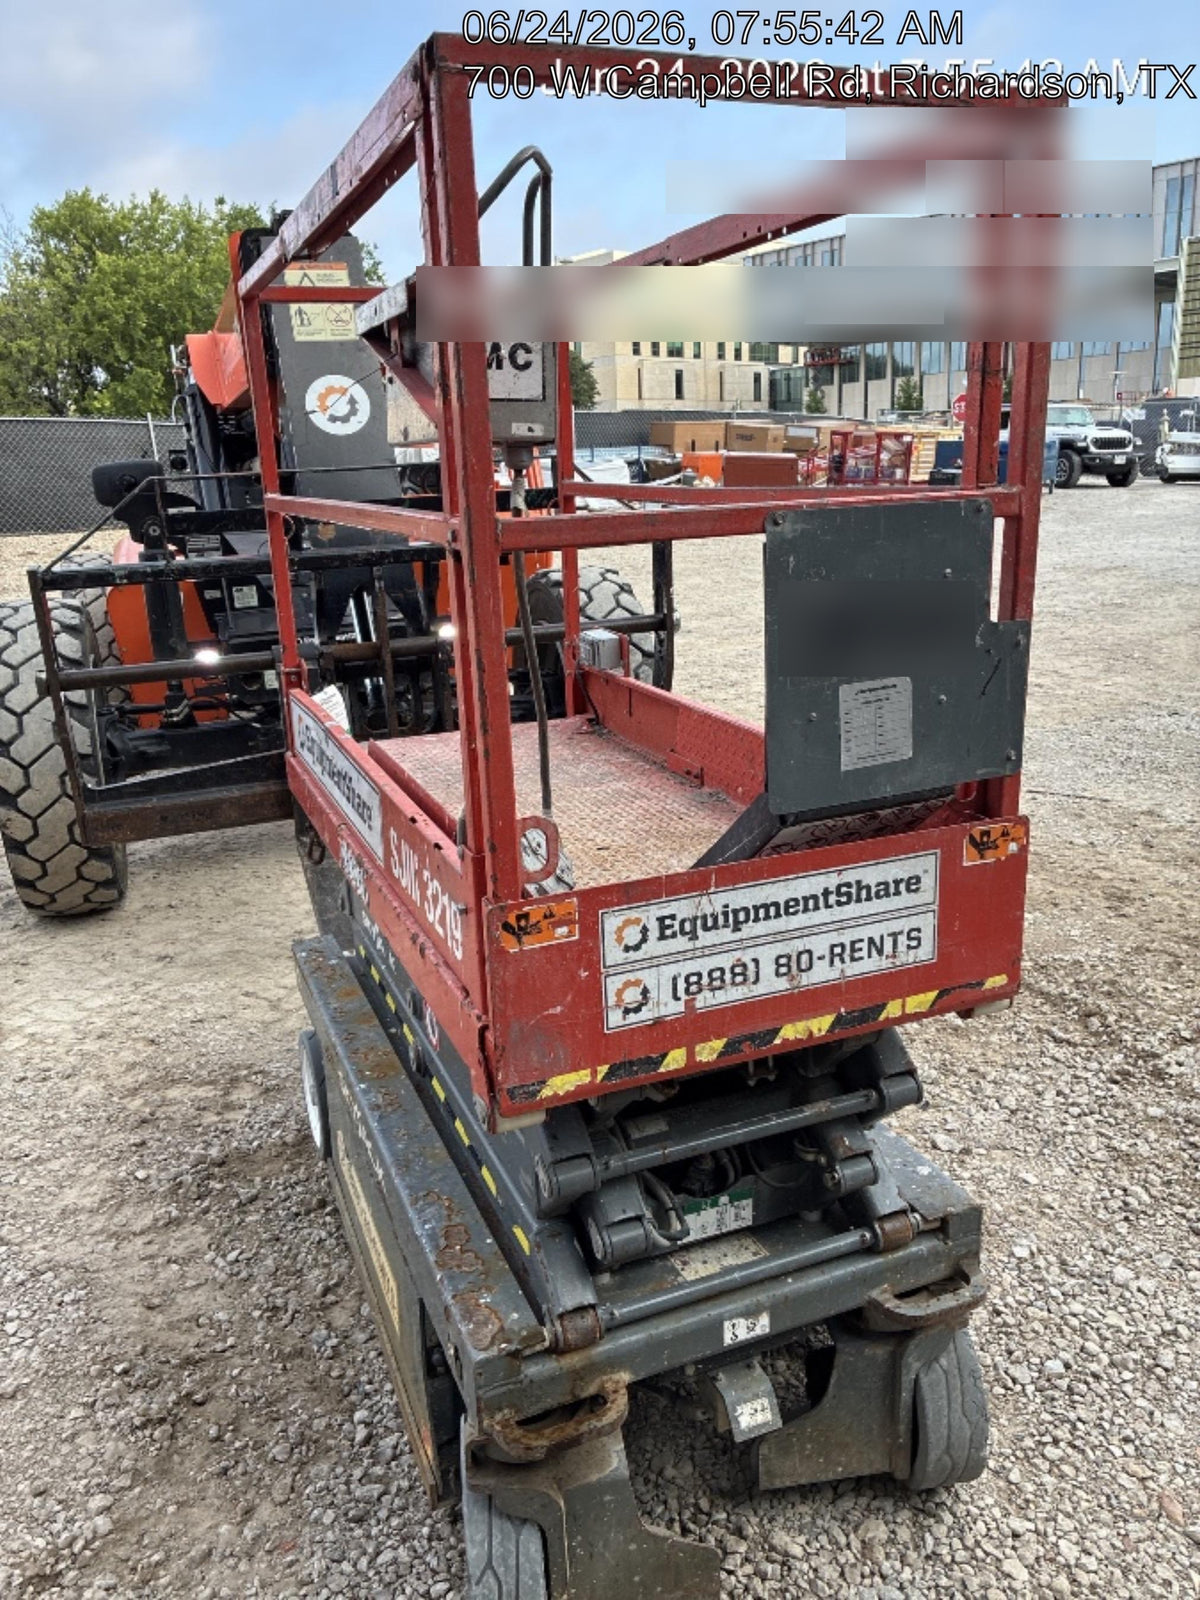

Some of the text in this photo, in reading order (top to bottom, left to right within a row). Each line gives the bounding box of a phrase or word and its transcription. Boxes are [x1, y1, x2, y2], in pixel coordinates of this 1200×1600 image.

[422, 869, 463, 961] 3219
[656, 873, 922, 942] EquipmentShare
[672, 927, 922, 1002] (888) 80-RENTS
